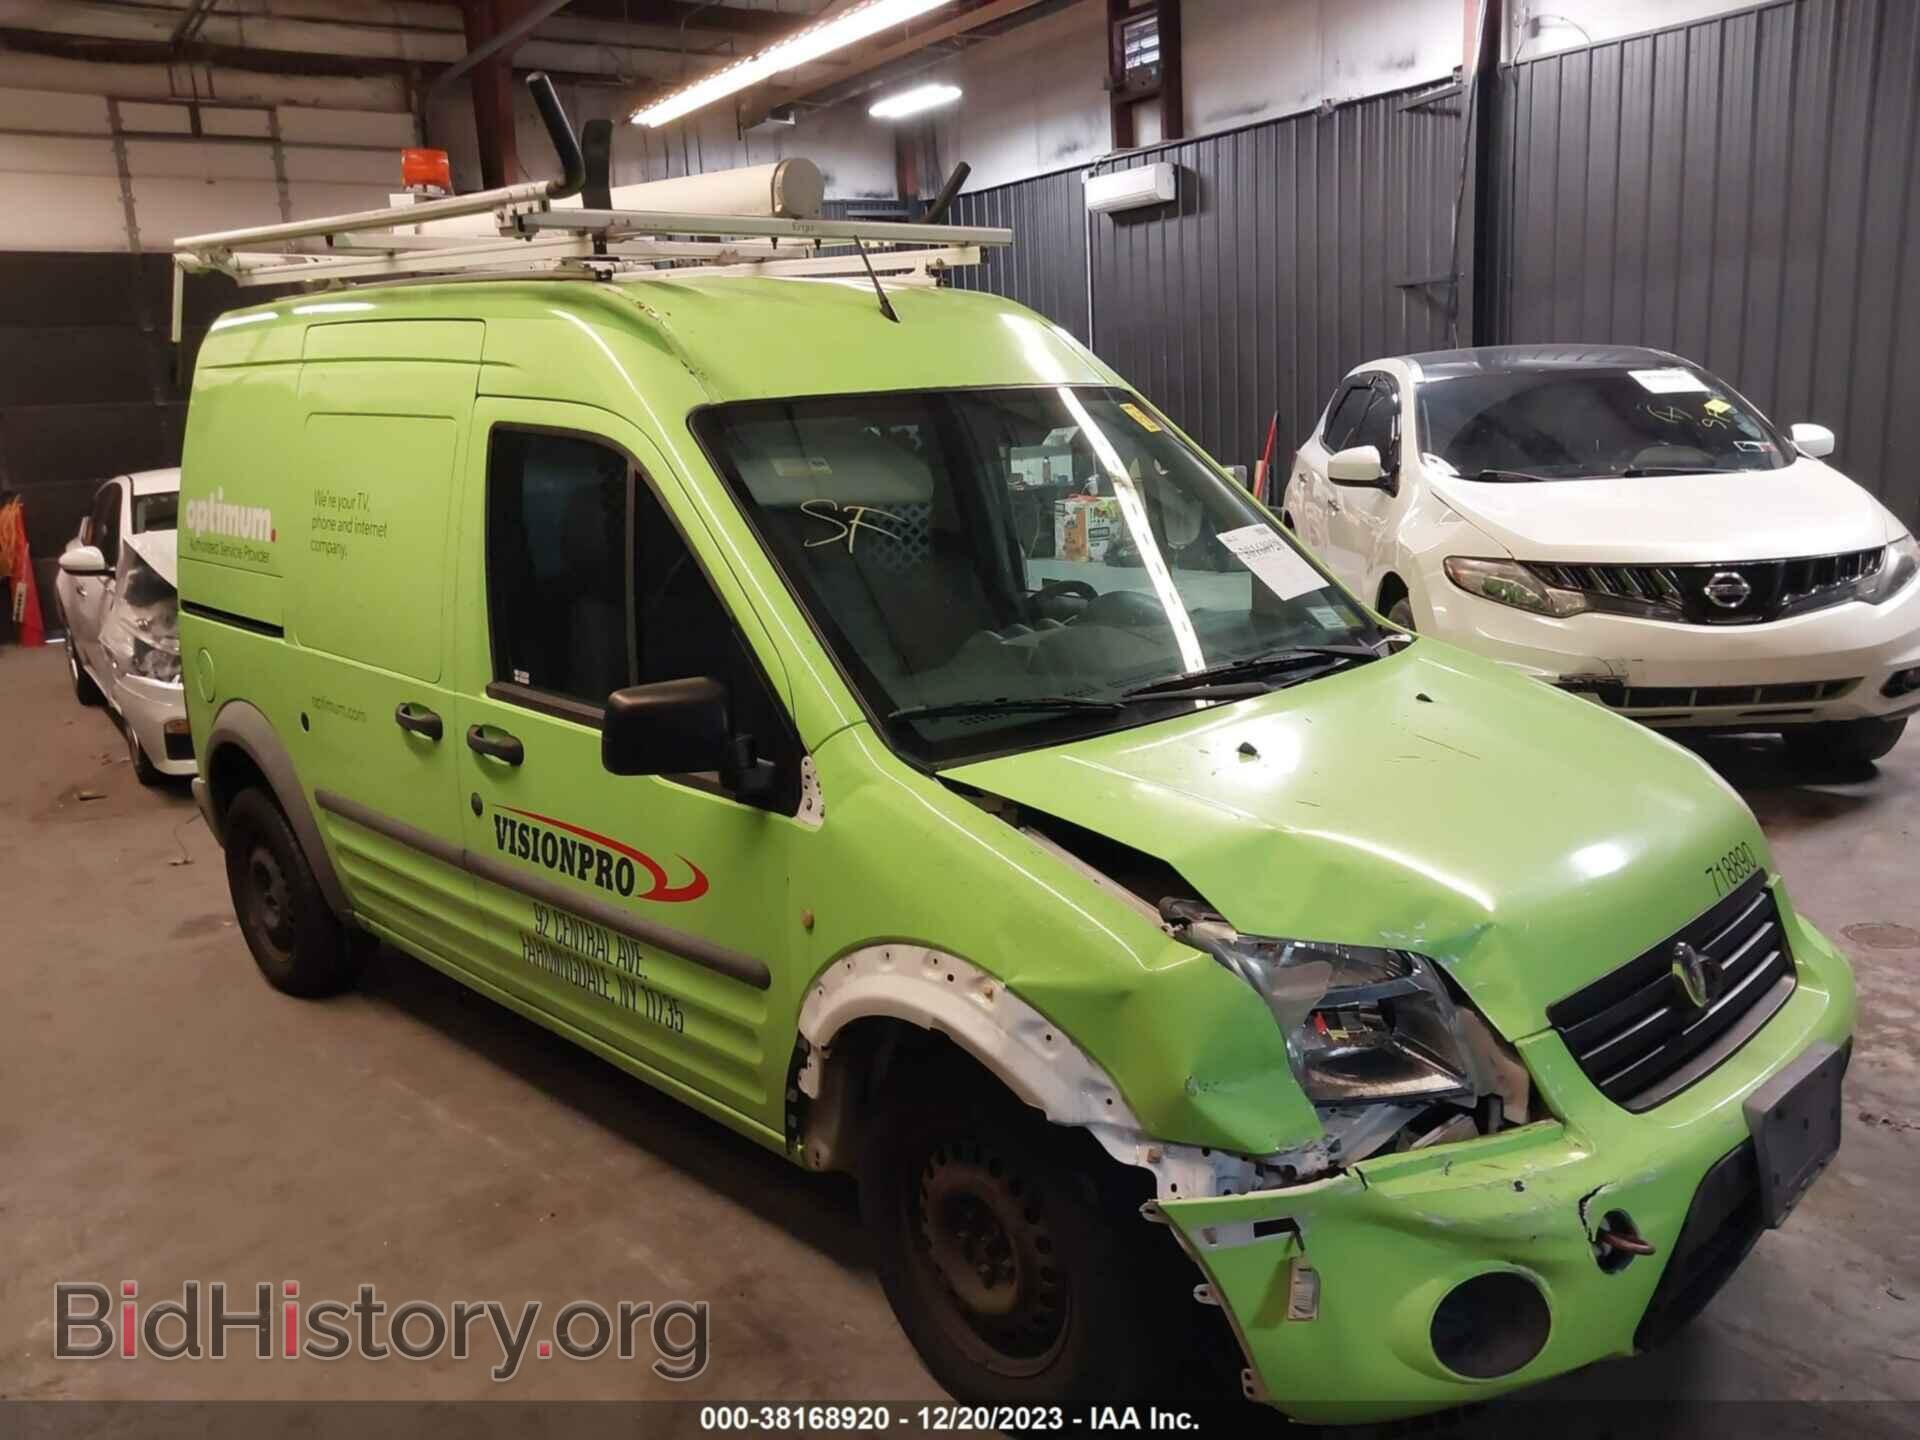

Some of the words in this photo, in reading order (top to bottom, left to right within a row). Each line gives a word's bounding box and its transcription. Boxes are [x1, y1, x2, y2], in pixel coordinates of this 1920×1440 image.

[311, 515, 337, 533] phone
[337, 516, 353, 534] and
[354, 516, 388, 538] internet
[314, 488, 337, 508] We're
[337, 496, 356, 513] your
[800, 499, 907, 554] SF
[494, 814, 635, 897] VISIONPRO
[1705, 841, 1757, 897] 718890
[533, 902, 550, 938] 92
[553, 910, 614, 965] CENTRAL
[617, 974, 638, 1013] NY
[640, 985, 684, 1033] 11735
